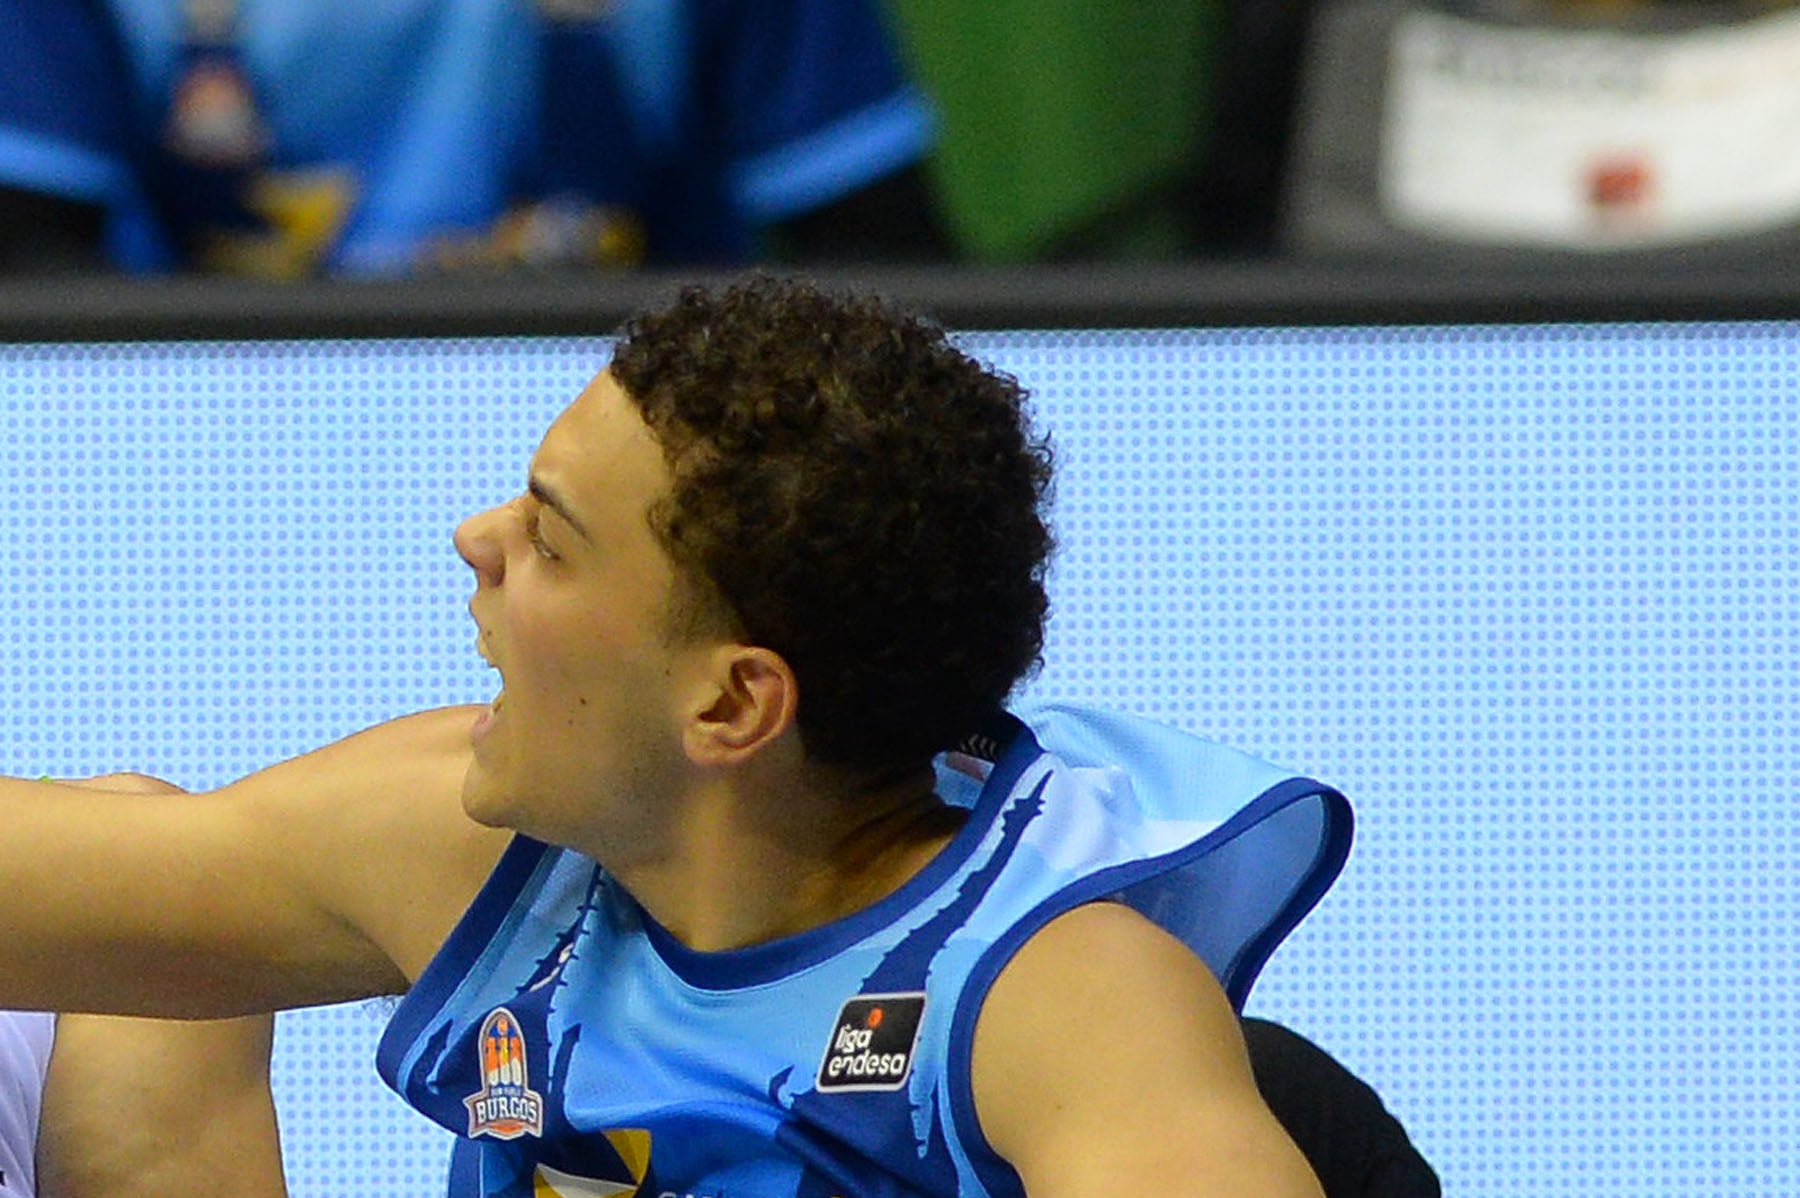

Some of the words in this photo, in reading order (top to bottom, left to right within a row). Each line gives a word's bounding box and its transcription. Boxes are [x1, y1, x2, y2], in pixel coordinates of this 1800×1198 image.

[835, 1024, 873, 1054] liga
[828, 1050, 907, 1078] endesa
[475, 1097, 538, 1124] BURGOS
